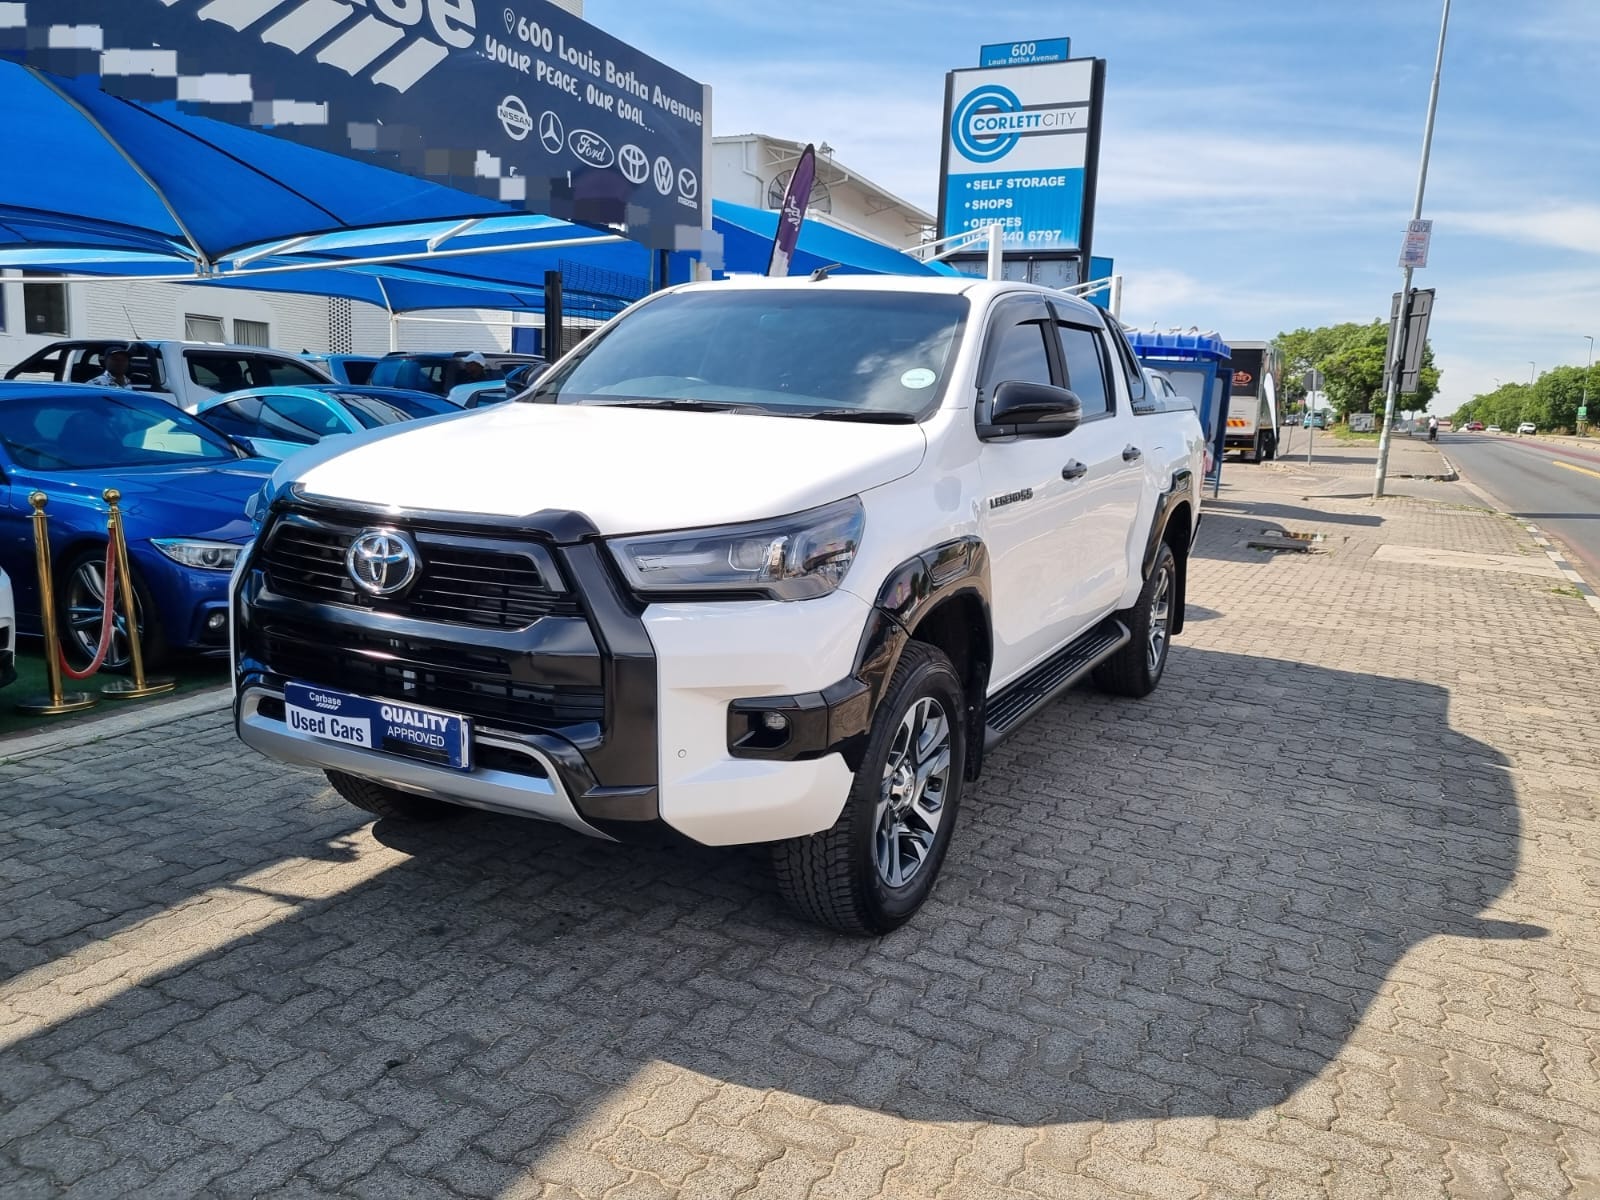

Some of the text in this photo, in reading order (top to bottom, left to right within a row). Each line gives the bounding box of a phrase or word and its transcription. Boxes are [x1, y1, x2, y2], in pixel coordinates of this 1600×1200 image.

[1011, 43, 1036, 56] 600
[1008, 56, 1029, 64] Botha
[1031, 54, 1059, 62] Avenue
[518, 17, 552, 52] 600
[559, 35, 600, 77] Louis
[606, 60, 648, 101] Botha
[653, 85, 702, 126] Avenue
[537, 59, 581, 102] PEACE,
[586, 84, 613, 112] OUR
[499, 108, 531, 127] NISSAN
[577, 134, 606, 161] Ford
[973, 176, 1066, 190] SELF STORAGE
[972, 198, 1013, 210] SHOPS
[970, 217, 1022, 229] OFFICES
[1028, 230, 1061, 241] 6797
[309, 692, 341, 706] Carbase
[291, 710, 364, 742] Used Cars
[381, 705, 449, 732] QUALITY
[387, 725, 445, 747] APPROVED
